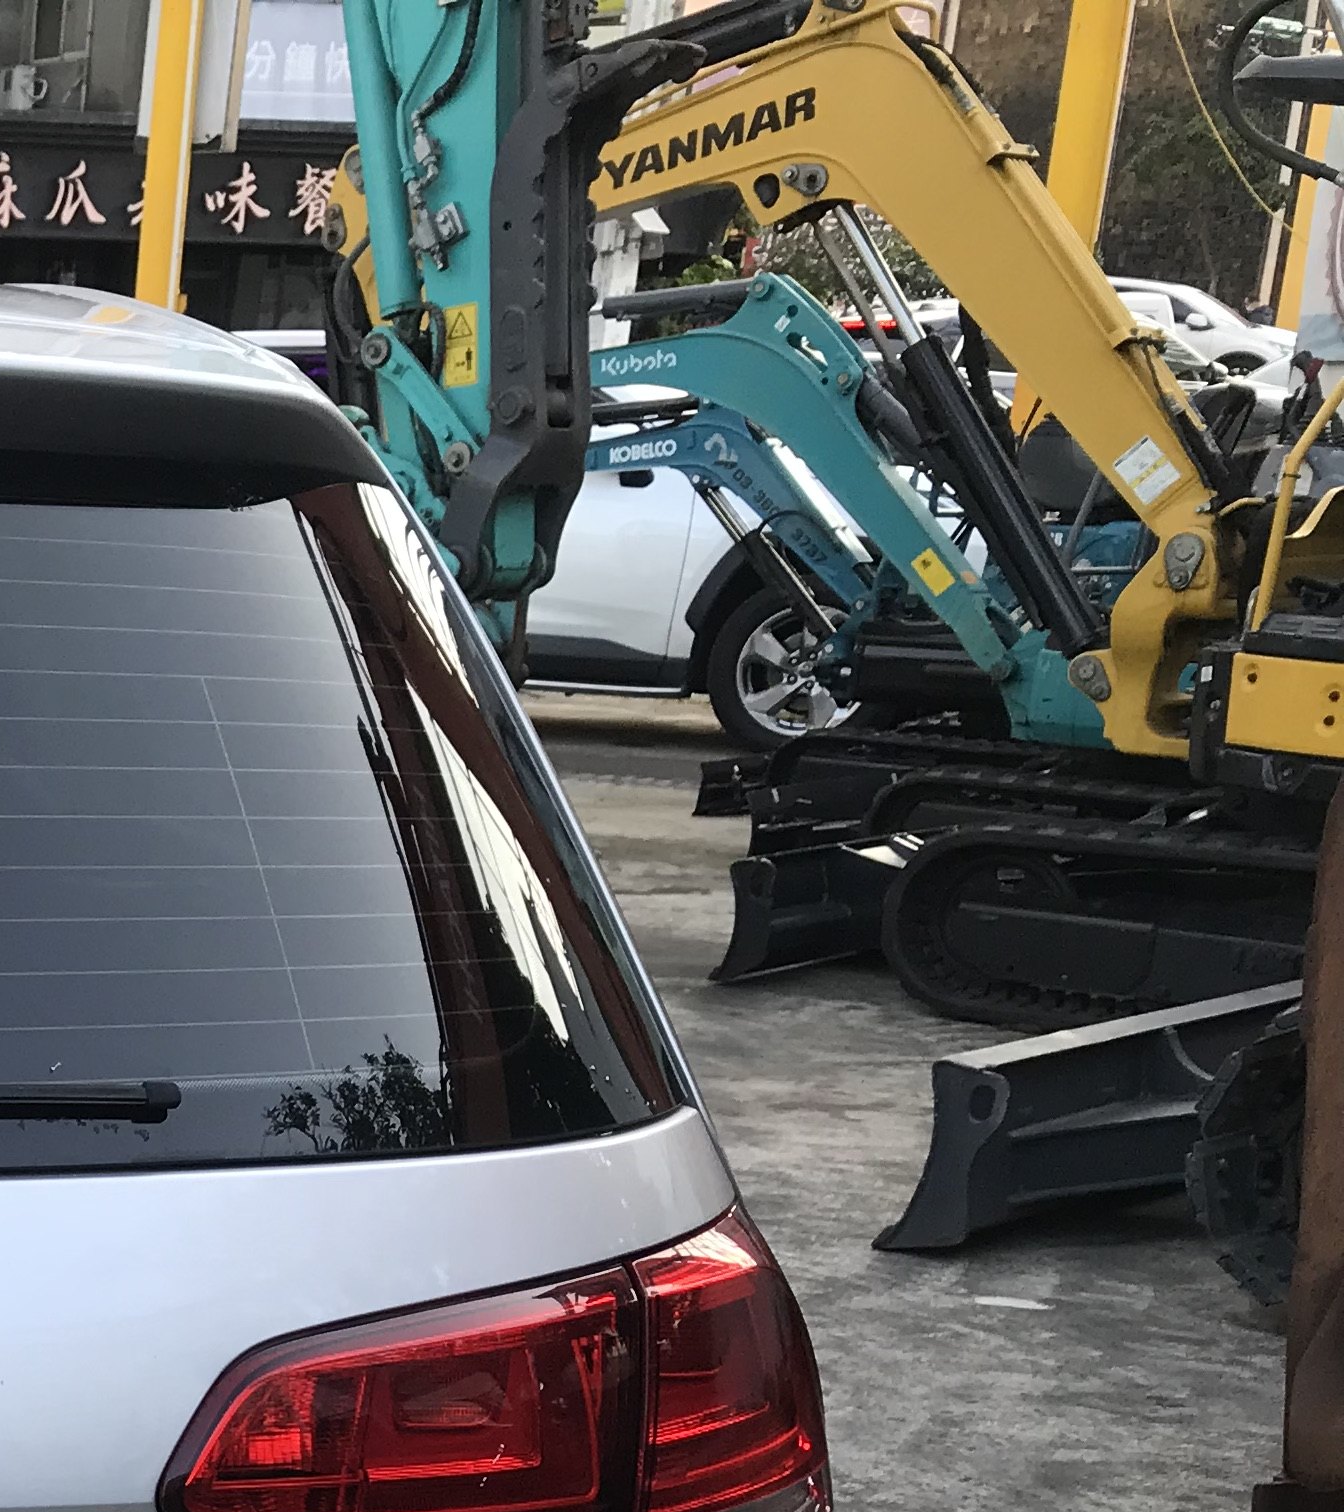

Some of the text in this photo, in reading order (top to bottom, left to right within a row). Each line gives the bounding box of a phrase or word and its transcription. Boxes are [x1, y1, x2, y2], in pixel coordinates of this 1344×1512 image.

[603, 87, 816, 189] YANMAR
[601, 349, 677, 376] Kubota
[609, 439, 677, 465] KOBELCO
